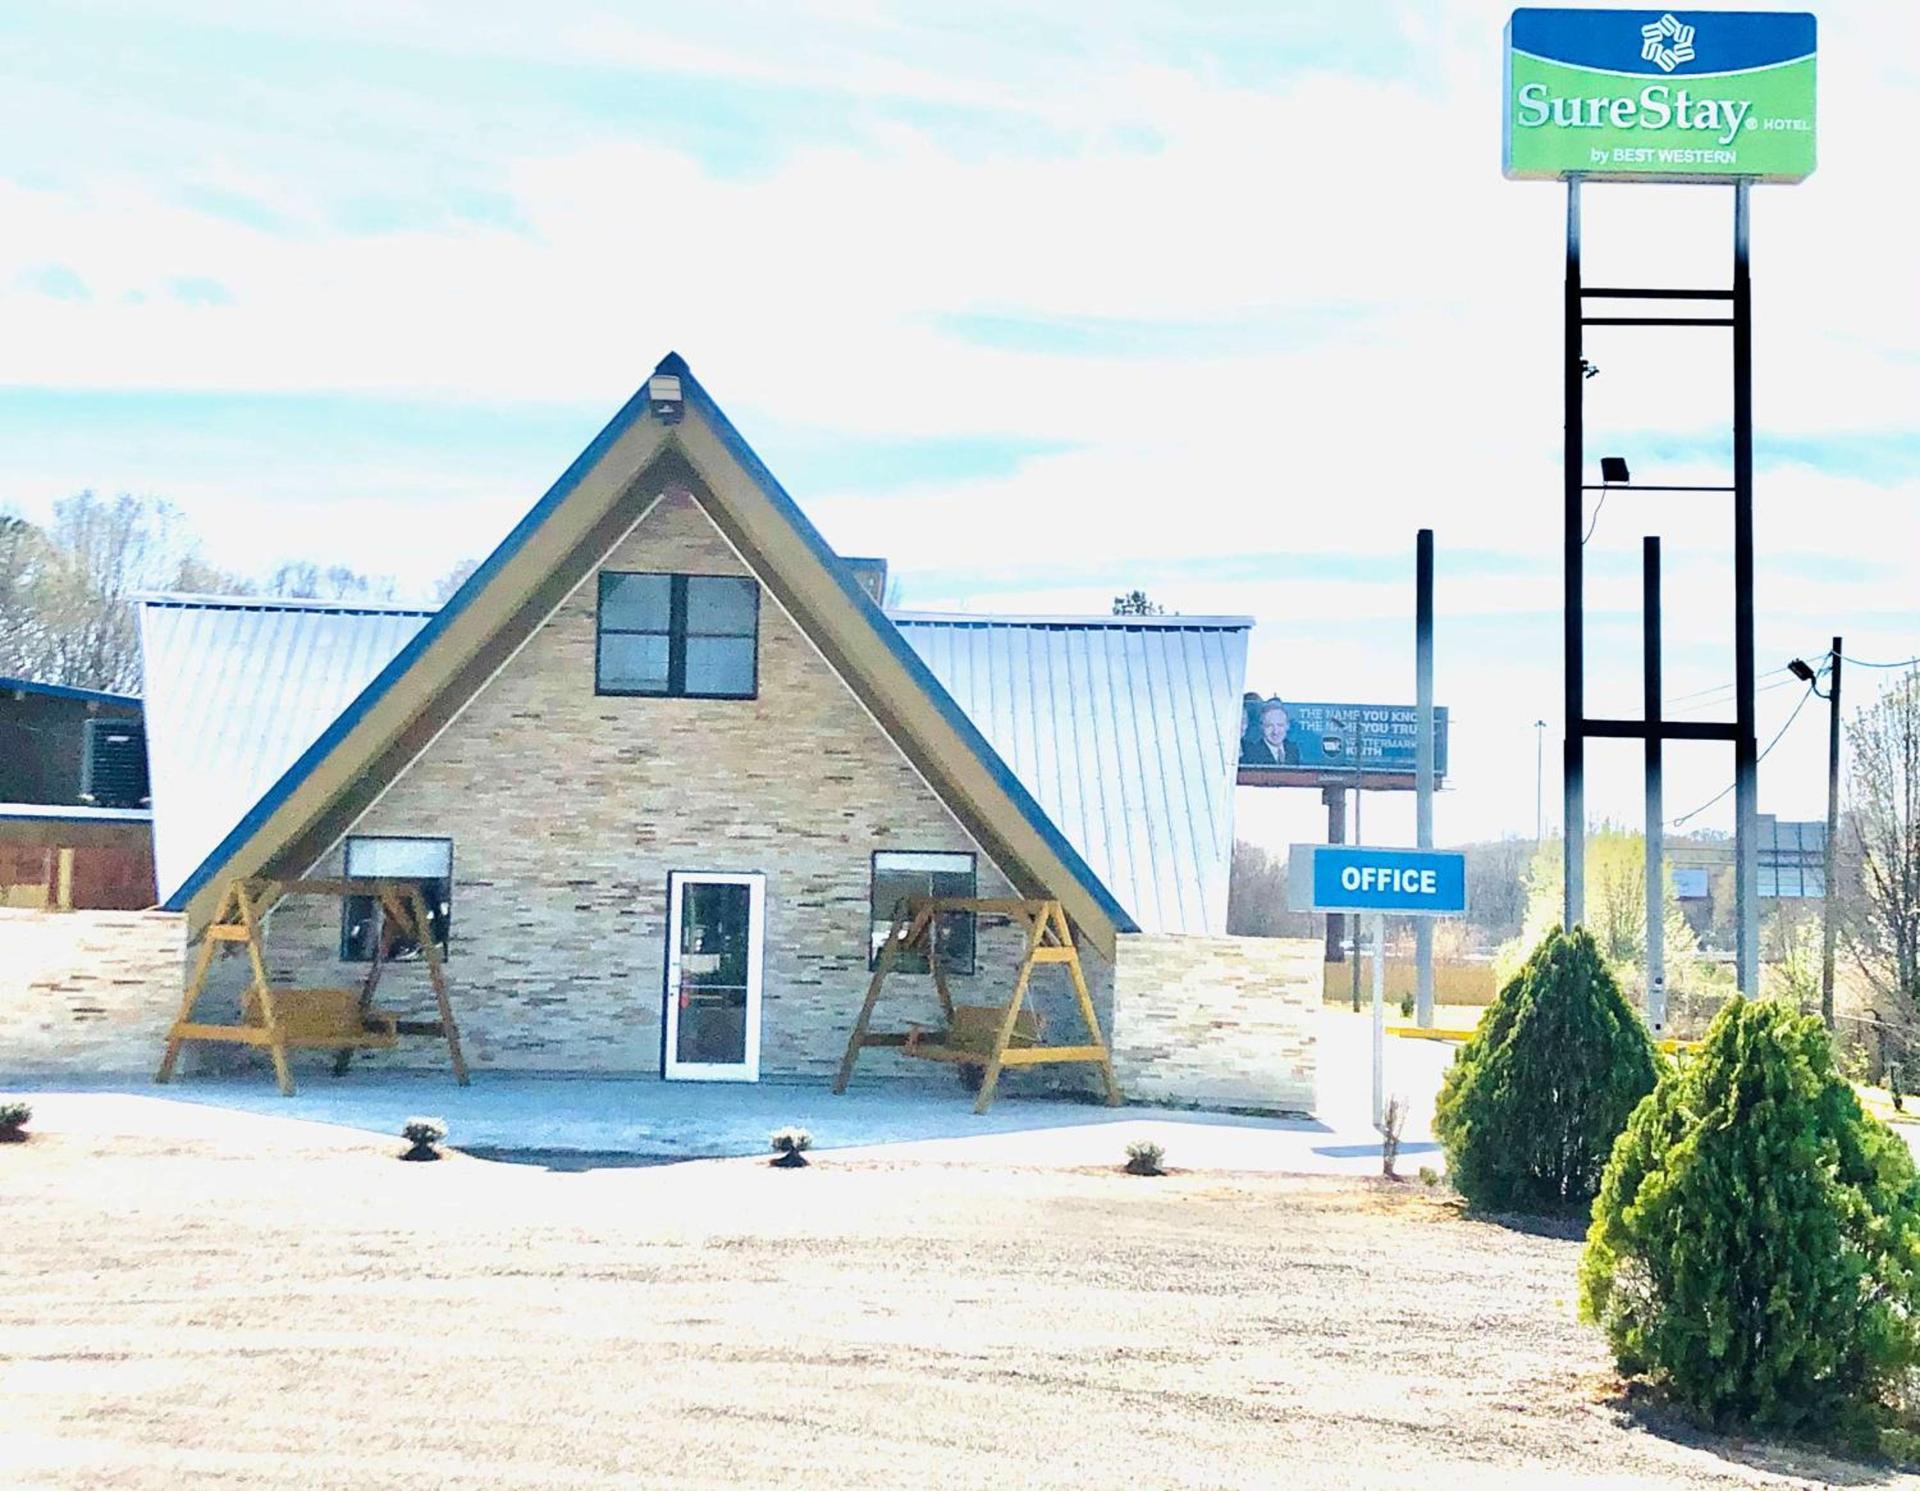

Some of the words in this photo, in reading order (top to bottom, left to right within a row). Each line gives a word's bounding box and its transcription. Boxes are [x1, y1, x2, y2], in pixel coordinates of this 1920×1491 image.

[1763, 118, 1811, 131] HOTEL
[1590, 148, 1609, 165] by
[1613, 149, 1654, 163] BEST
[1658, 150, 1737, 164] WESTERN
[1299, 708, 1323, 720] THE
[1362, 710, 1389, 721] YOU
[1391, 711, 1418, 722] KNO
[1299, 719, 1323, 731] THE
[1360, 722, 1389, 733] YOU
[1391, 723, 1418, 735] TRU
[1341, 866, 1437, 894] OFFICE
